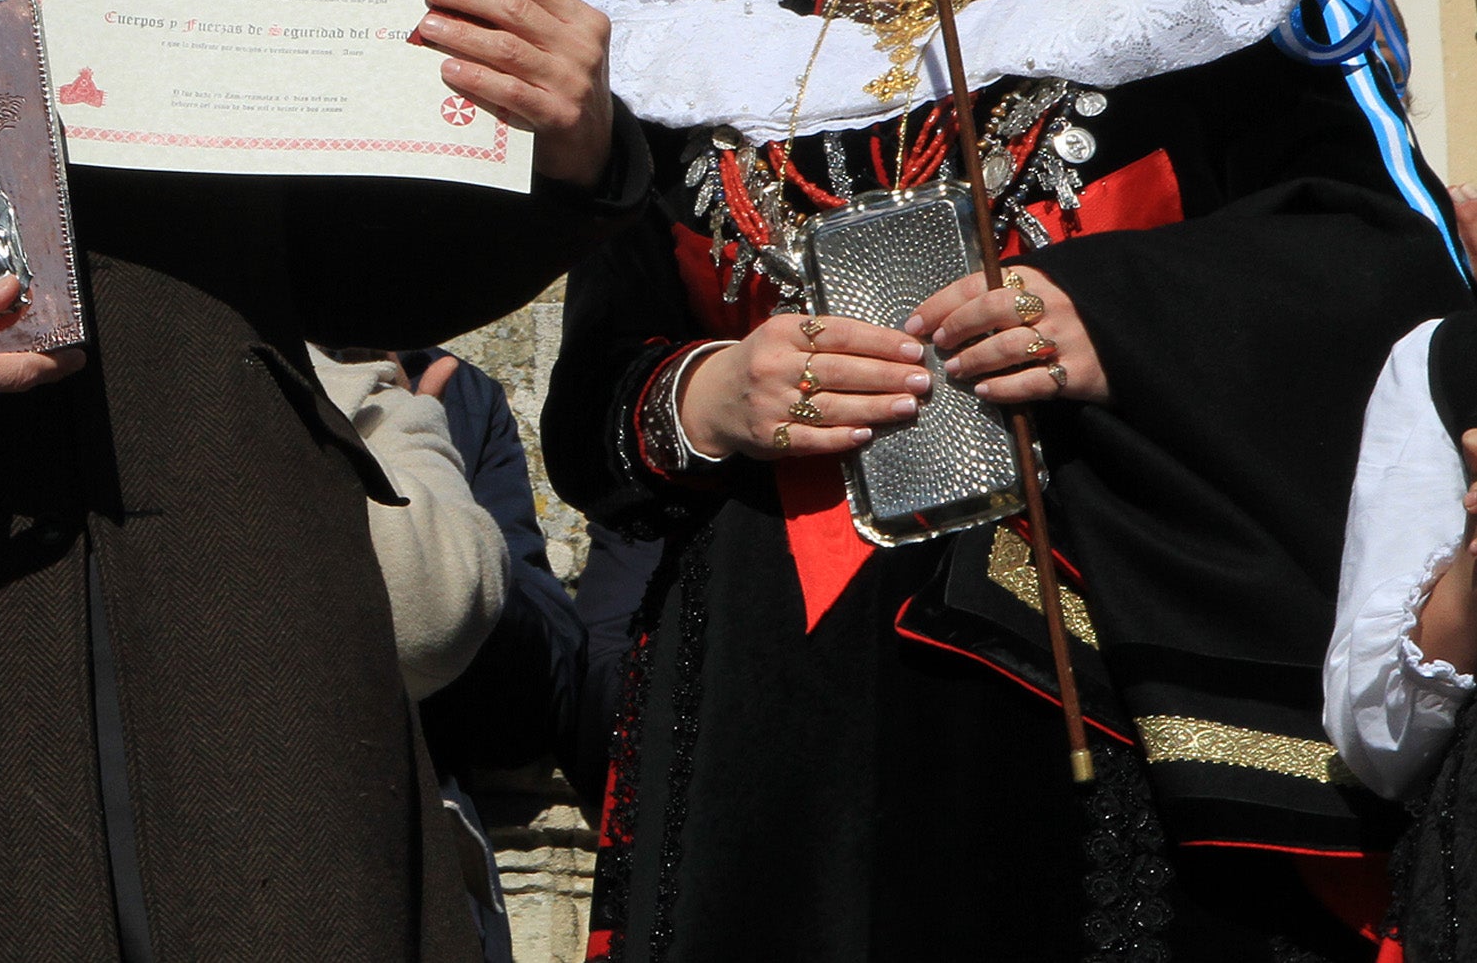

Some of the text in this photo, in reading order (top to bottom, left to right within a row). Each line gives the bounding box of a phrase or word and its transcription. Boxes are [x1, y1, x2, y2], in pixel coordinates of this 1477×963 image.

[104, 10, 165, 29] Cuerpos
[168, 19, 178, 30] y
[182, 18, 244, 35] Fuerzas
[247, 23, 264, 36] de
[268, 24, 345, 39] Seguridad
[349, 27, 370, 40] del
